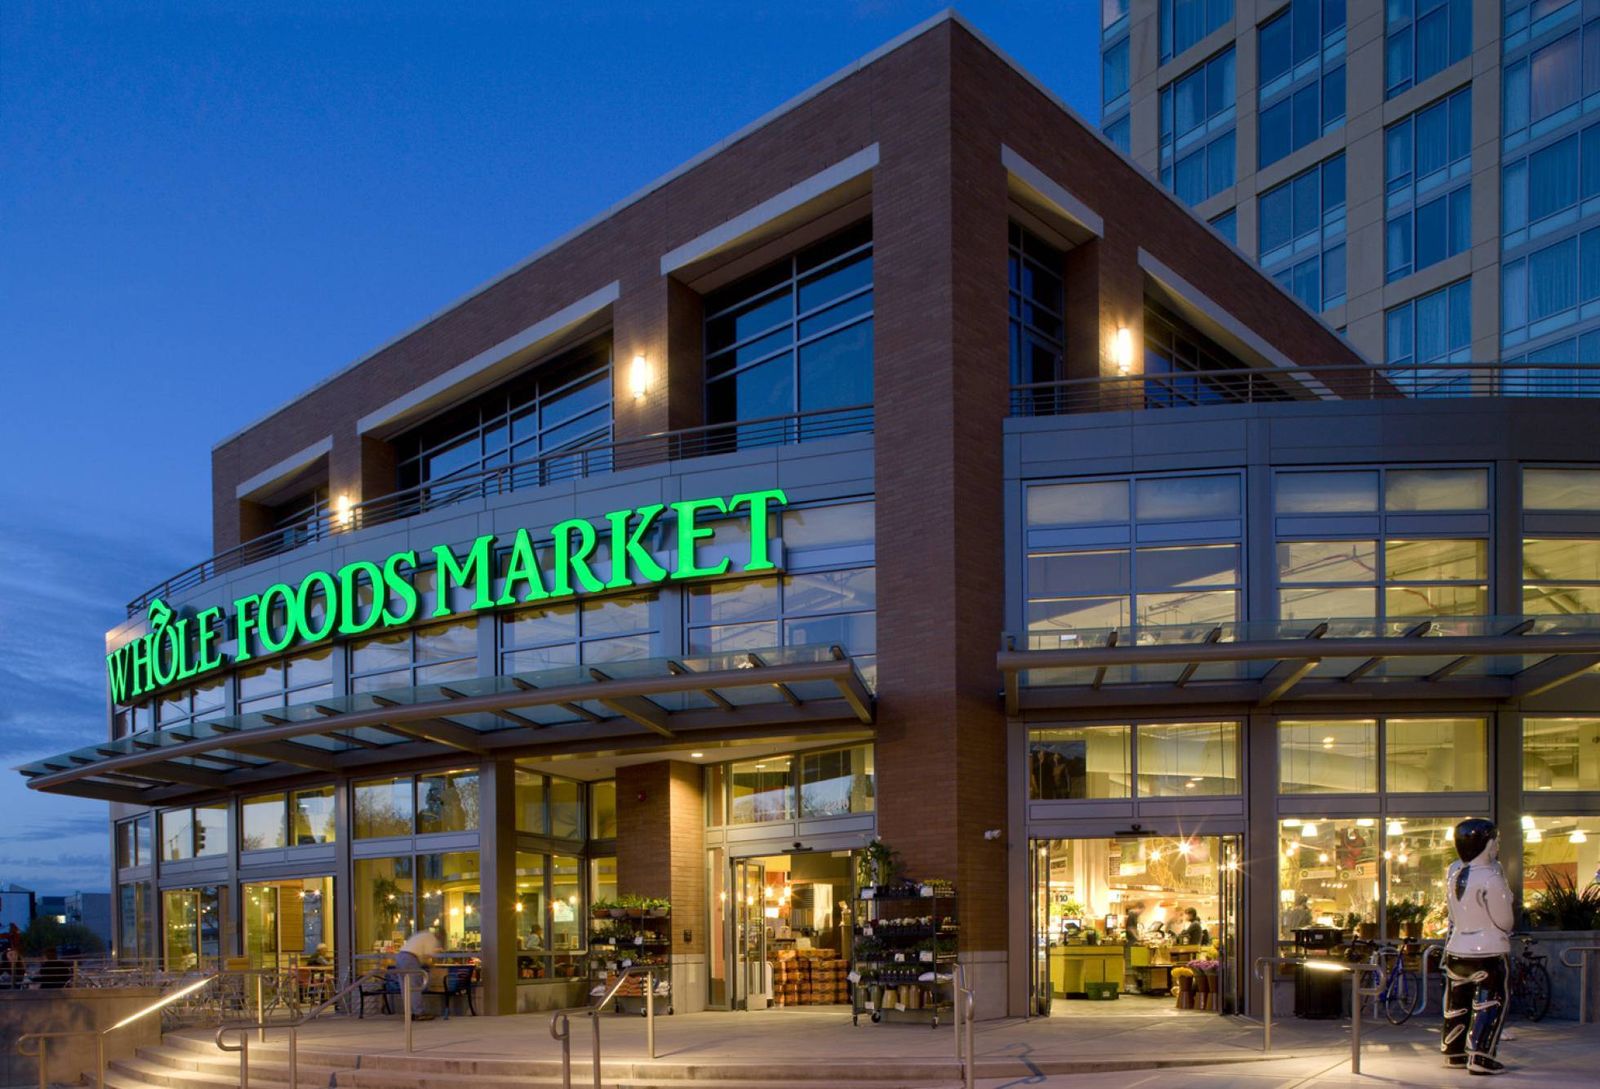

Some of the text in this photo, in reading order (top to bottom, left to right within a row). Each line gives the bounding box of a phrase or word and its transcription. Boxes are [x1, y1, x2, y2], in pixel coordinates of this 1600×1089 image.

[106, 488, 789, 705] WHOLE FOODS MARKET
